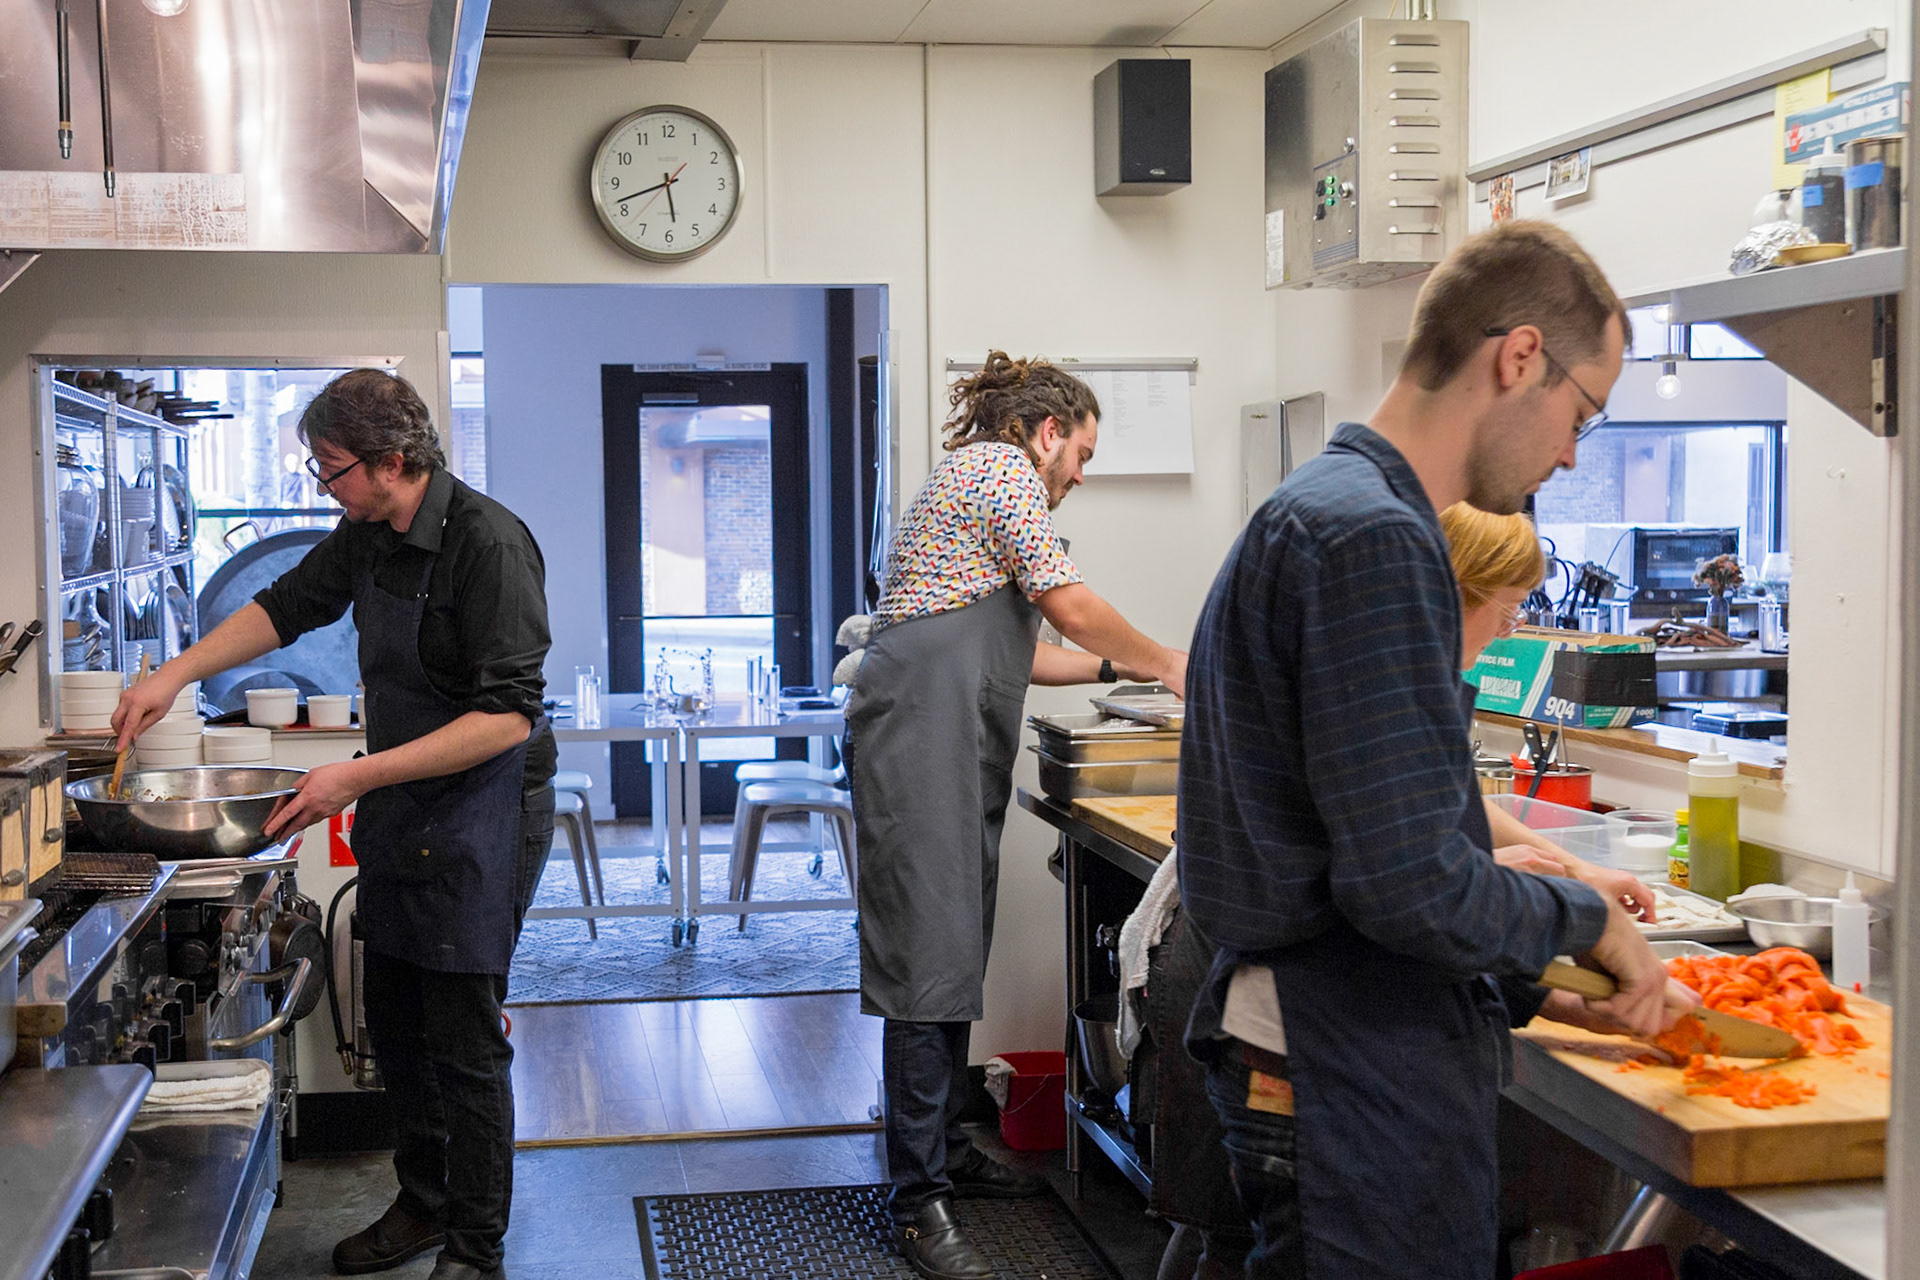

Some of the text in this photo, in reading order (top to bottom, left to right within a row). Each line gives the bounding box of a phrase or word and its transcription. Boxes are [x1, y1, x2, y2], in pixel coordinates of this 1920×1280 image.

[662, 125, 675, 138] 12
[637, 133, 648, 146] 11
[692, 133, 697, 146] 1
[617, 152, 632, 165] 10
[710, 151, 718, 164] 2
[611, 177, 620, 190] 9
[717, 177, 726, 190] 3
[620, 204, 629, 217] 8
[708, 203, 717, 215] 4
[639, 223, 647, 236] 7
[691, 223, 699, 236] 5
[665, 230, 674, 243] 6
[1476, 654, 1515, 667] RVICE FILM
[1544, 696, 1576, 719] 904
